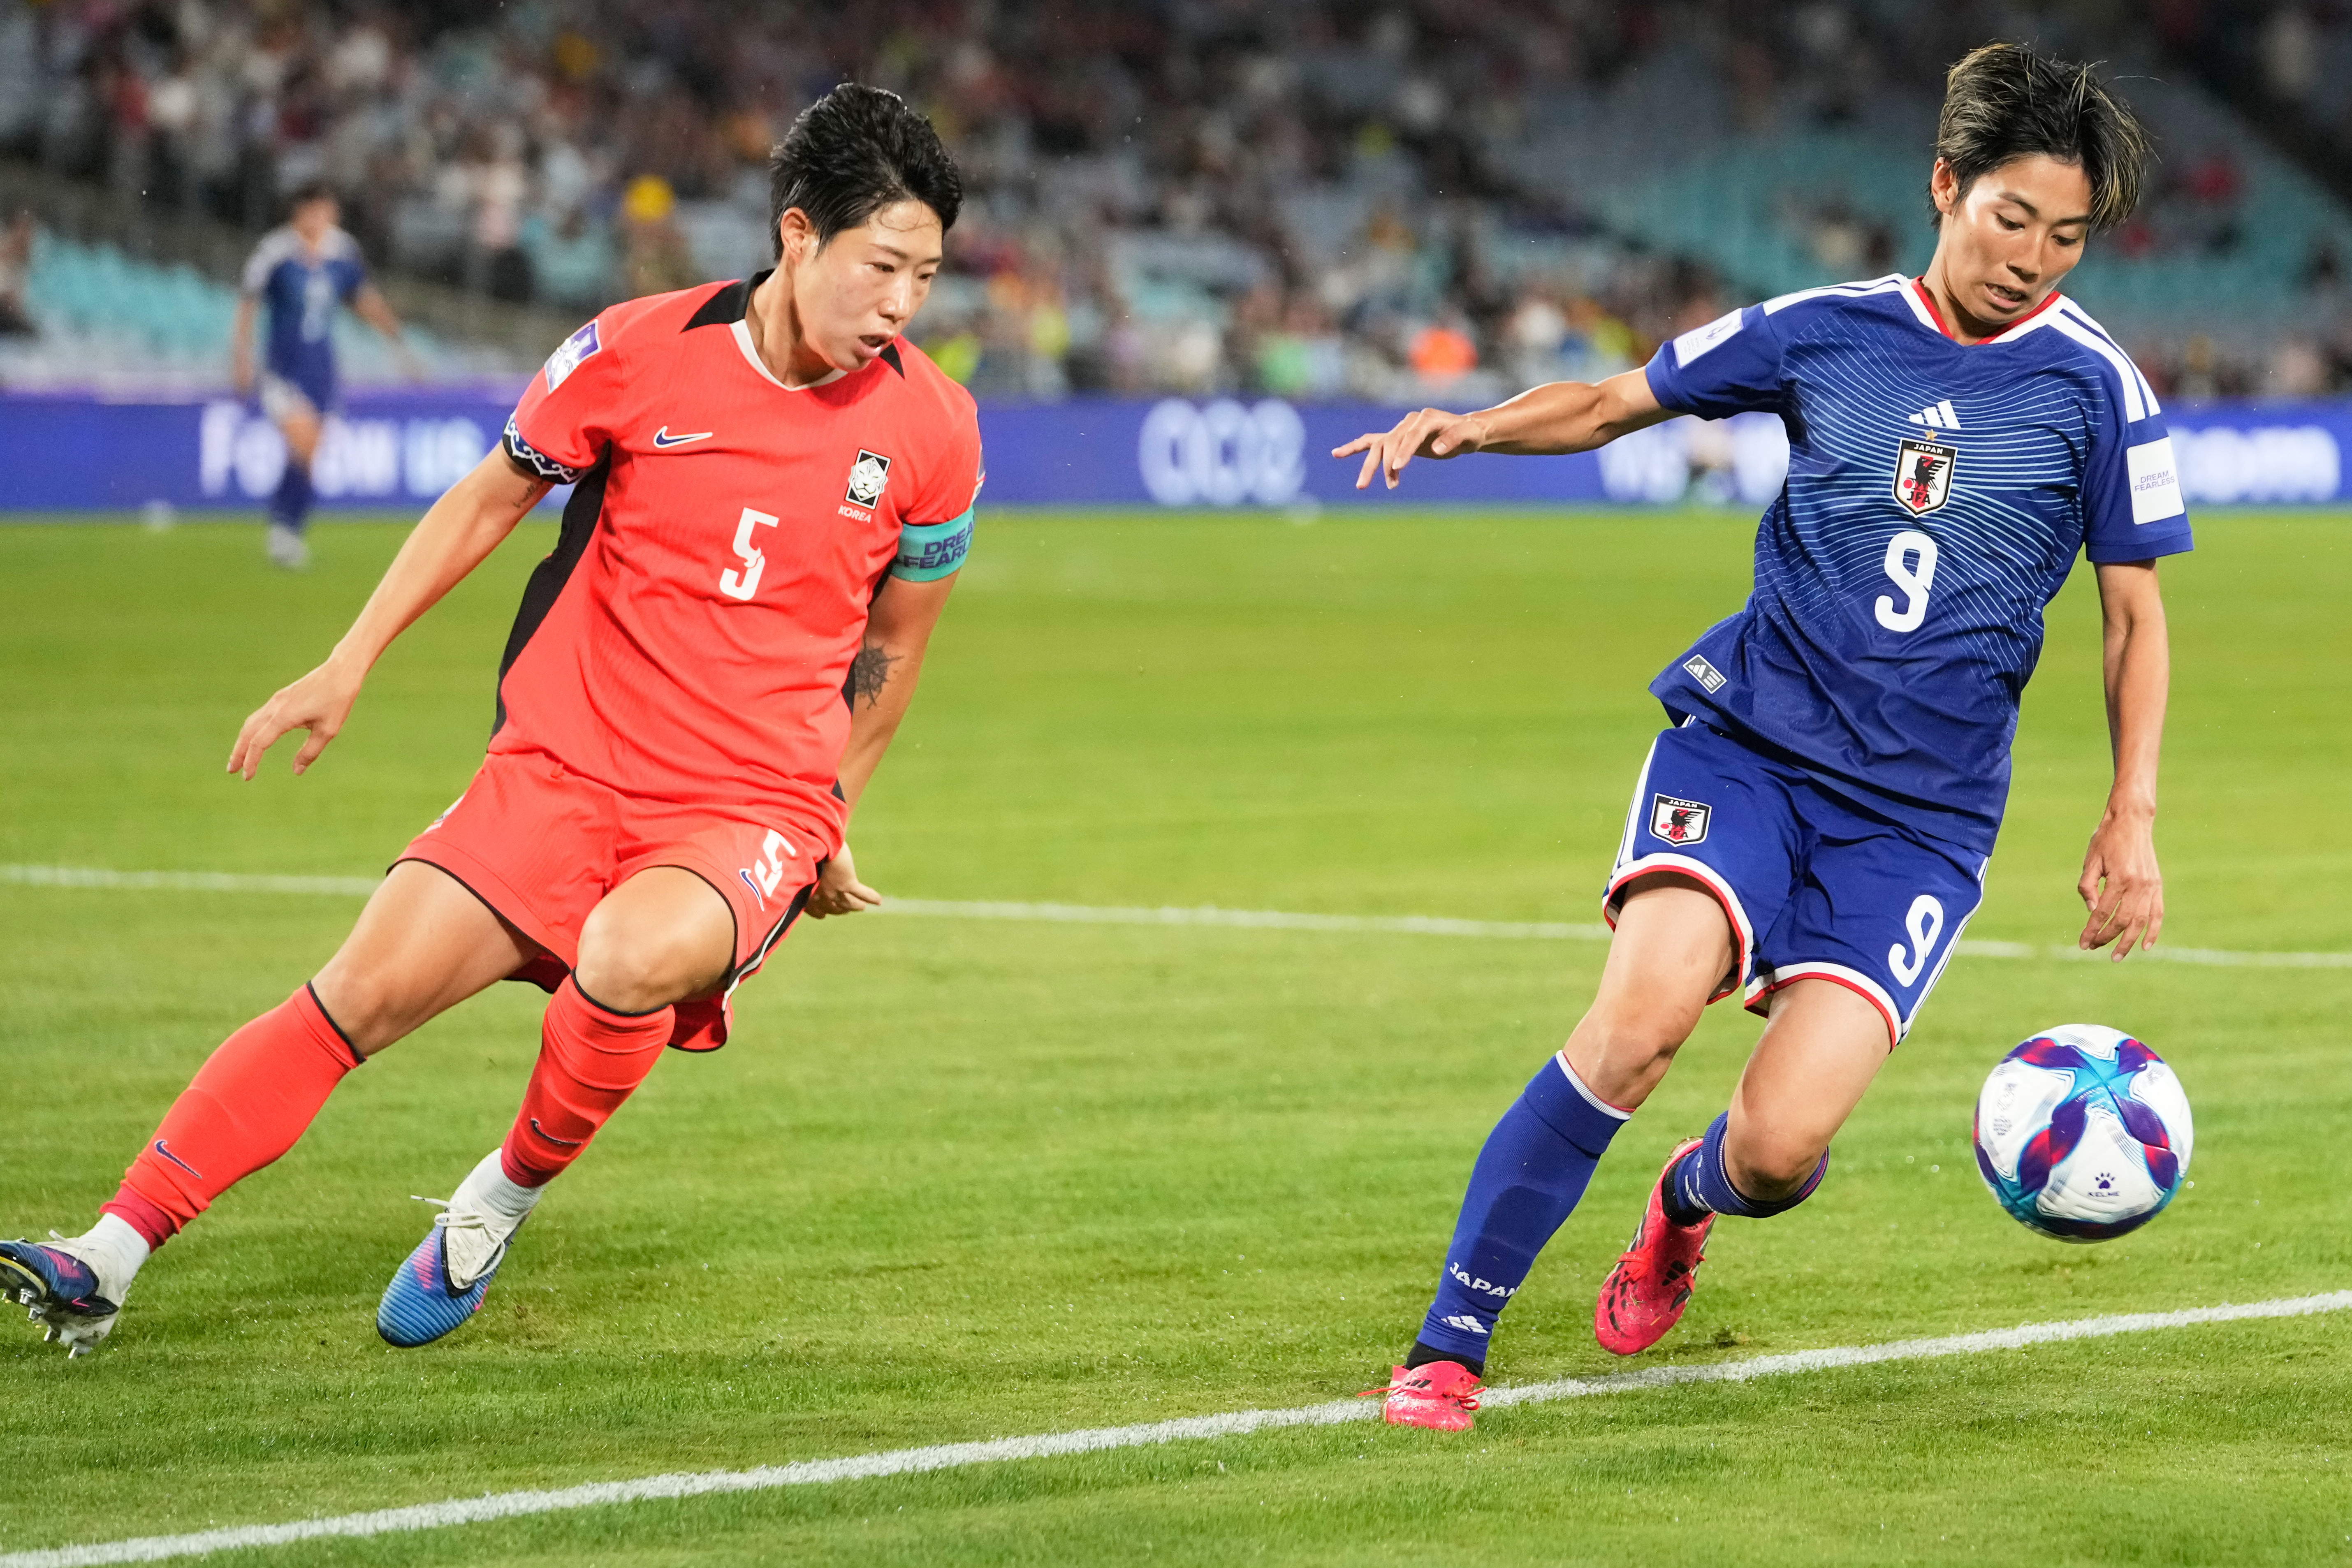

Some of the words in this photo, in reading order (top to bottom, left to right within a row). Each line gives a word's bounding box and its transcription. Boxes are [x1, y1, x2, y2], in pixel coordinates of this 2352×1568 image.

[1914, 443, 1944, 454] JAPAN
[2134, 476, 2175, 492] FEARLESS
[2140, 470, 2169, 484] DREAM
[1906, 491, 1930, 505] JFA
[837, 505, 872, 523] KOREA
[924, 521, 973, 556] DREA
[719, 507, 779, 601] 5
[1874, 531, 1938, 632] 9
[1668, 799, 1698, 808] JAPAN
[1665, 830, 1689, 838] JFA
[754, 828, 797, 898] 5
[1888, 894, 1944, 988] 9
